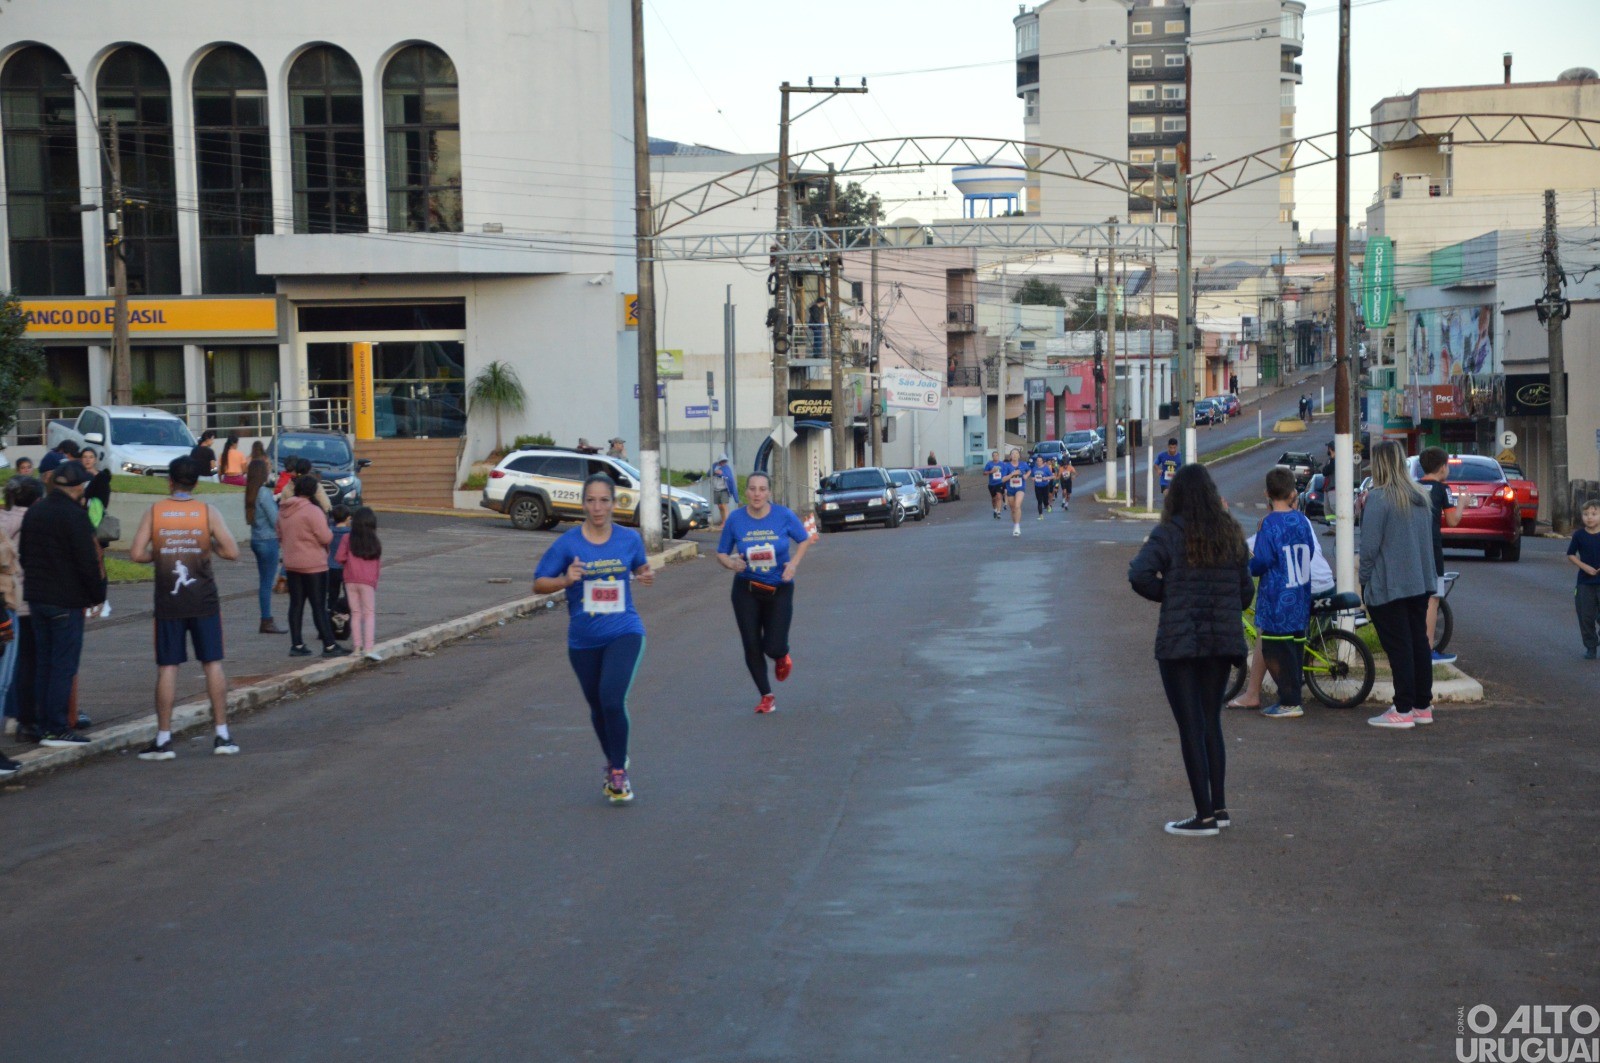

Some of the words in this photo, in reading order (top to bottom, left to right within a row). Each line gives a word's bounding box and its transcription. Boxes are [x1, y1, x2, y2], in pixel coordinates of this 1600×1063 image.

[77, 310, 100, 324] DO
[104, 307, 167, 324] BASIL
[916, 379, 938, 389] João
[927, 393, 935, 403] E
[1504, 434, 1512, 446] E
[552, 489, 580, 500] 12251
[1282, 543, 1310, 588] 10
